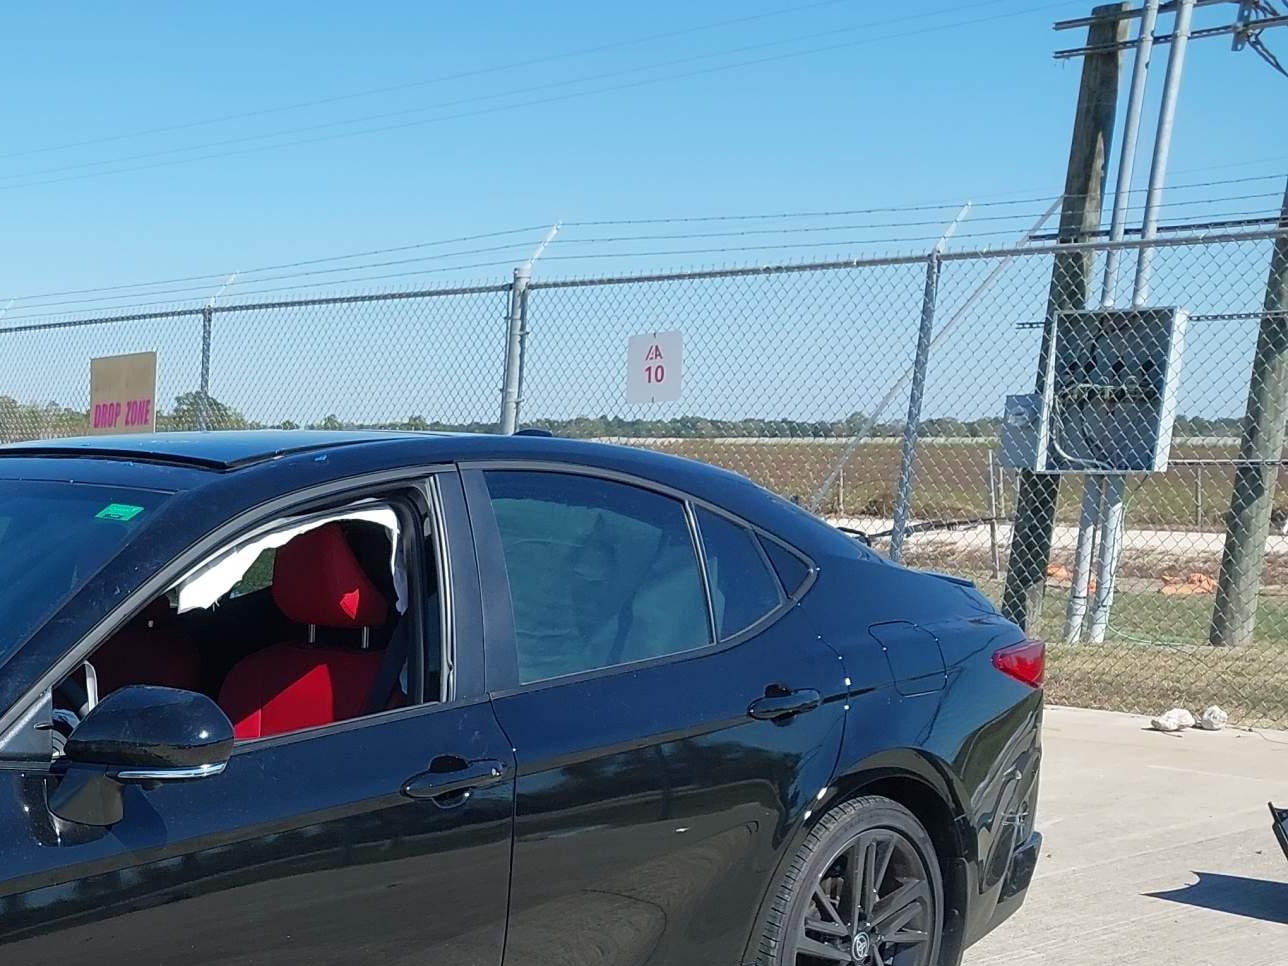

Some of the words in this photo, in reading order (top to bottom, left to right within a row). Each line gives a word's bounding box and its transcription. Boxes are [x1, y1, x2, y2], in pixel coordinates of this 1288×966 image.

[645, 365, 665, 384] 10
[94, 402, 121, 429] DROP
[124, 399, 151, 427] ZONE
